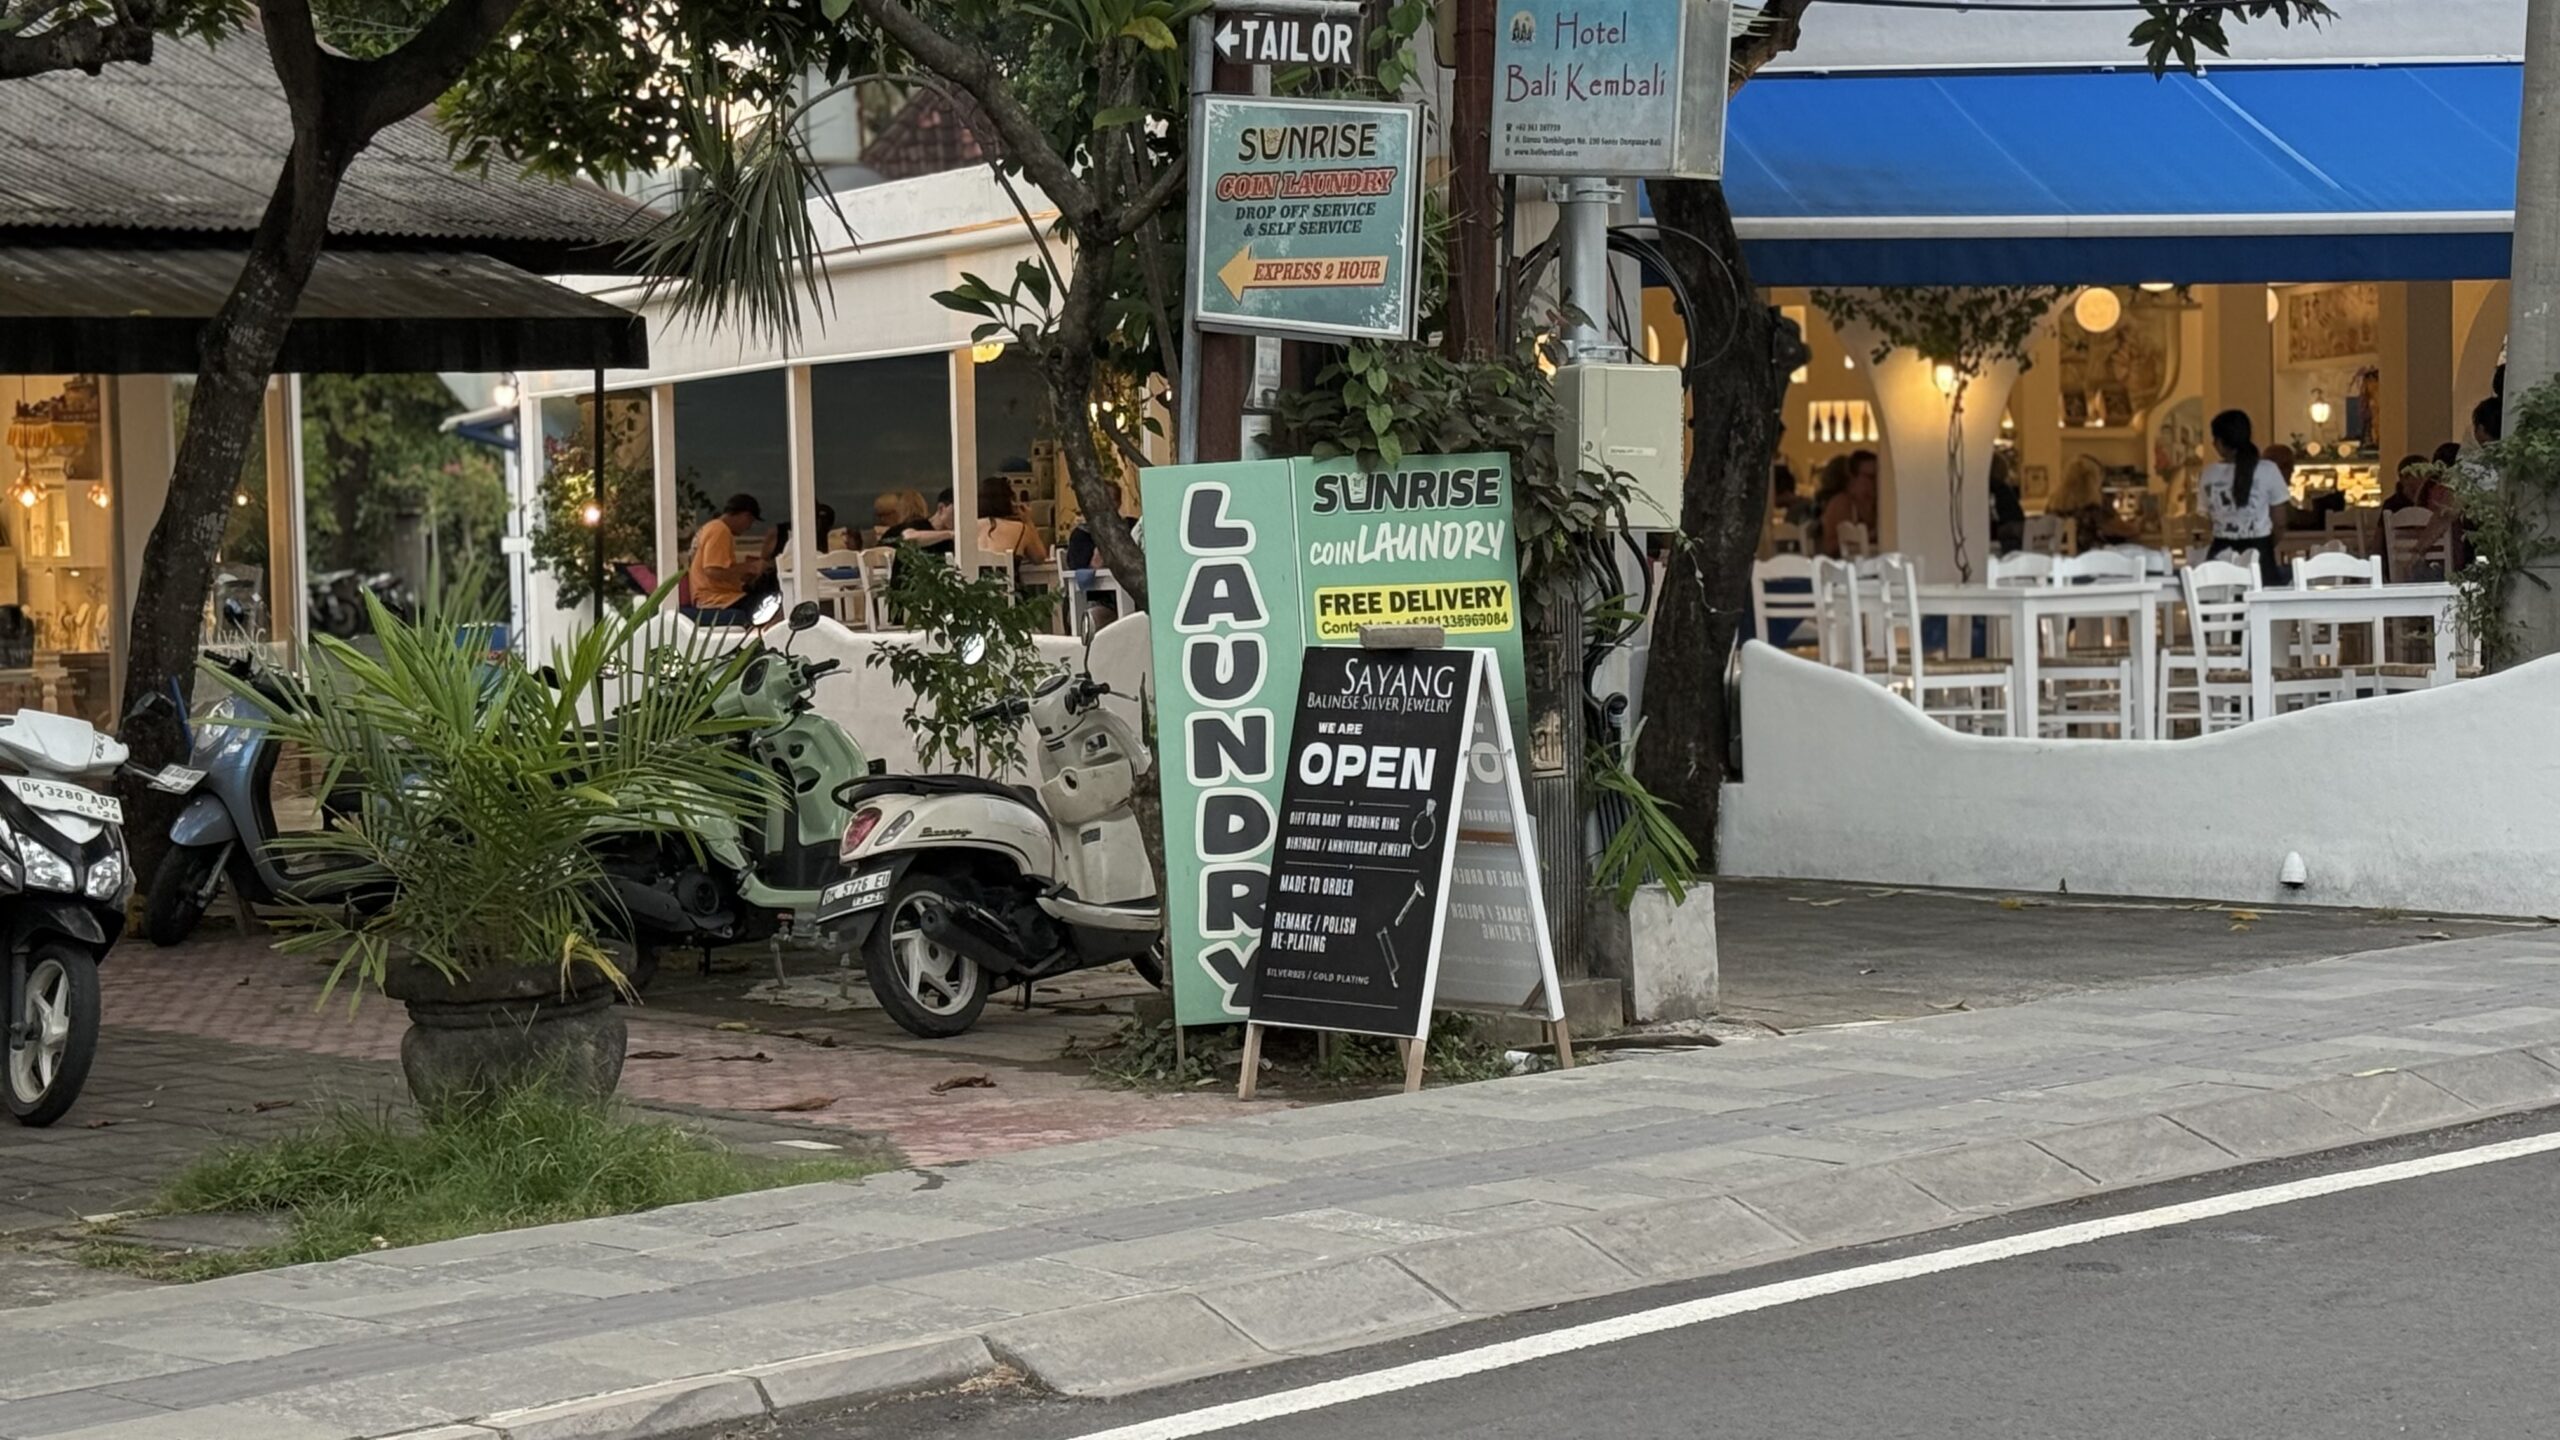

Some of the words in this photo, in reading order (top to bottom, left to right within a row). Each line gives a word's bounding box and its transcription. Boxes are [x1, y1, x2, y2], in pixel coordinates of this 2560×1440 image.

[1242, 20, 1353, 65] TAILOR
[1555, 11, 1628, 50] Hotel
[1505, 63, 1558, 102] Bali
[1566, 62, 1667, 101] Kembali
[1238, 124, 1378, 162] SUNRISE
[1217, 173, 1280, 200] COIN
[1280, 167, 1397, 199] LAUNDRY
[1235, 205, 1276, 220] DROP
[1280, 204, 1309, 219] OFF
[1312, 202, 1376, 217] SERVICE
[1243, 223, 1255, 237] &
[1258, 222, 1296, 236] SELF
[1299, 220, 1363, 235] SERVICE
[1253, 262, 1322, 281] EXPRESS
[1324, 262, 1335, 280] 2
[1337, 261, 1381, 280] HOUR
[1312, 468, 1501, 514] SUNRISE
[1310, 540, 1356, 566] COIN
[1357, 519, 1506, 565] LAUNDRY
[1319, 591, 1382, 617] FREE
[1389, 586, 1506, 613] DELIVERY
[1322, 619, 1373, 635] Conta
[1341, 658, 1456, 698] SAYANG
[1361, 693, 1399, 711] SILVER
[1400, 696, 1453, 715] JEWELRY
[1318, 721, 1336, 734] WE
[1337, 723, 1363, 735] ARE
[1174, 482, 1275, 1014] LAUNDRY
[1299, 742, 1437, 791] OPEN
[21, 782, 40, 793] DK
[46, 786, 84, 802] 3280
[90, 794, 118, 810] ADZ
[1289, 811, 1305, 825] GIFT
[1306, 812, 1320, 826] FOR
[1321, 813, 1341, 827] BABY
[1347, 814, 1380, 830] WEDDING
[1381, 817, 1400, 831] RING
[1285, 837, 1321, 852] BIRTHDAY
[1327, 839, 1378, 856] ANNIVERSARY
[1378, 842, 1412, 858] JEWELRY
[1279, 874, 1308, 893] MADE
[1309, 876, 1319, 894] TO
[1322, 877, 1354, 897] ORDER
[1274, 911, 1314, 932] REMAKE
[1314, 914, 1321, 933] /
[1322, 915, 1357, 935] POLISH
[1271, 932, 1327, 953] RE-PLATING
[1336, 974, 1370, 985] PLATING
